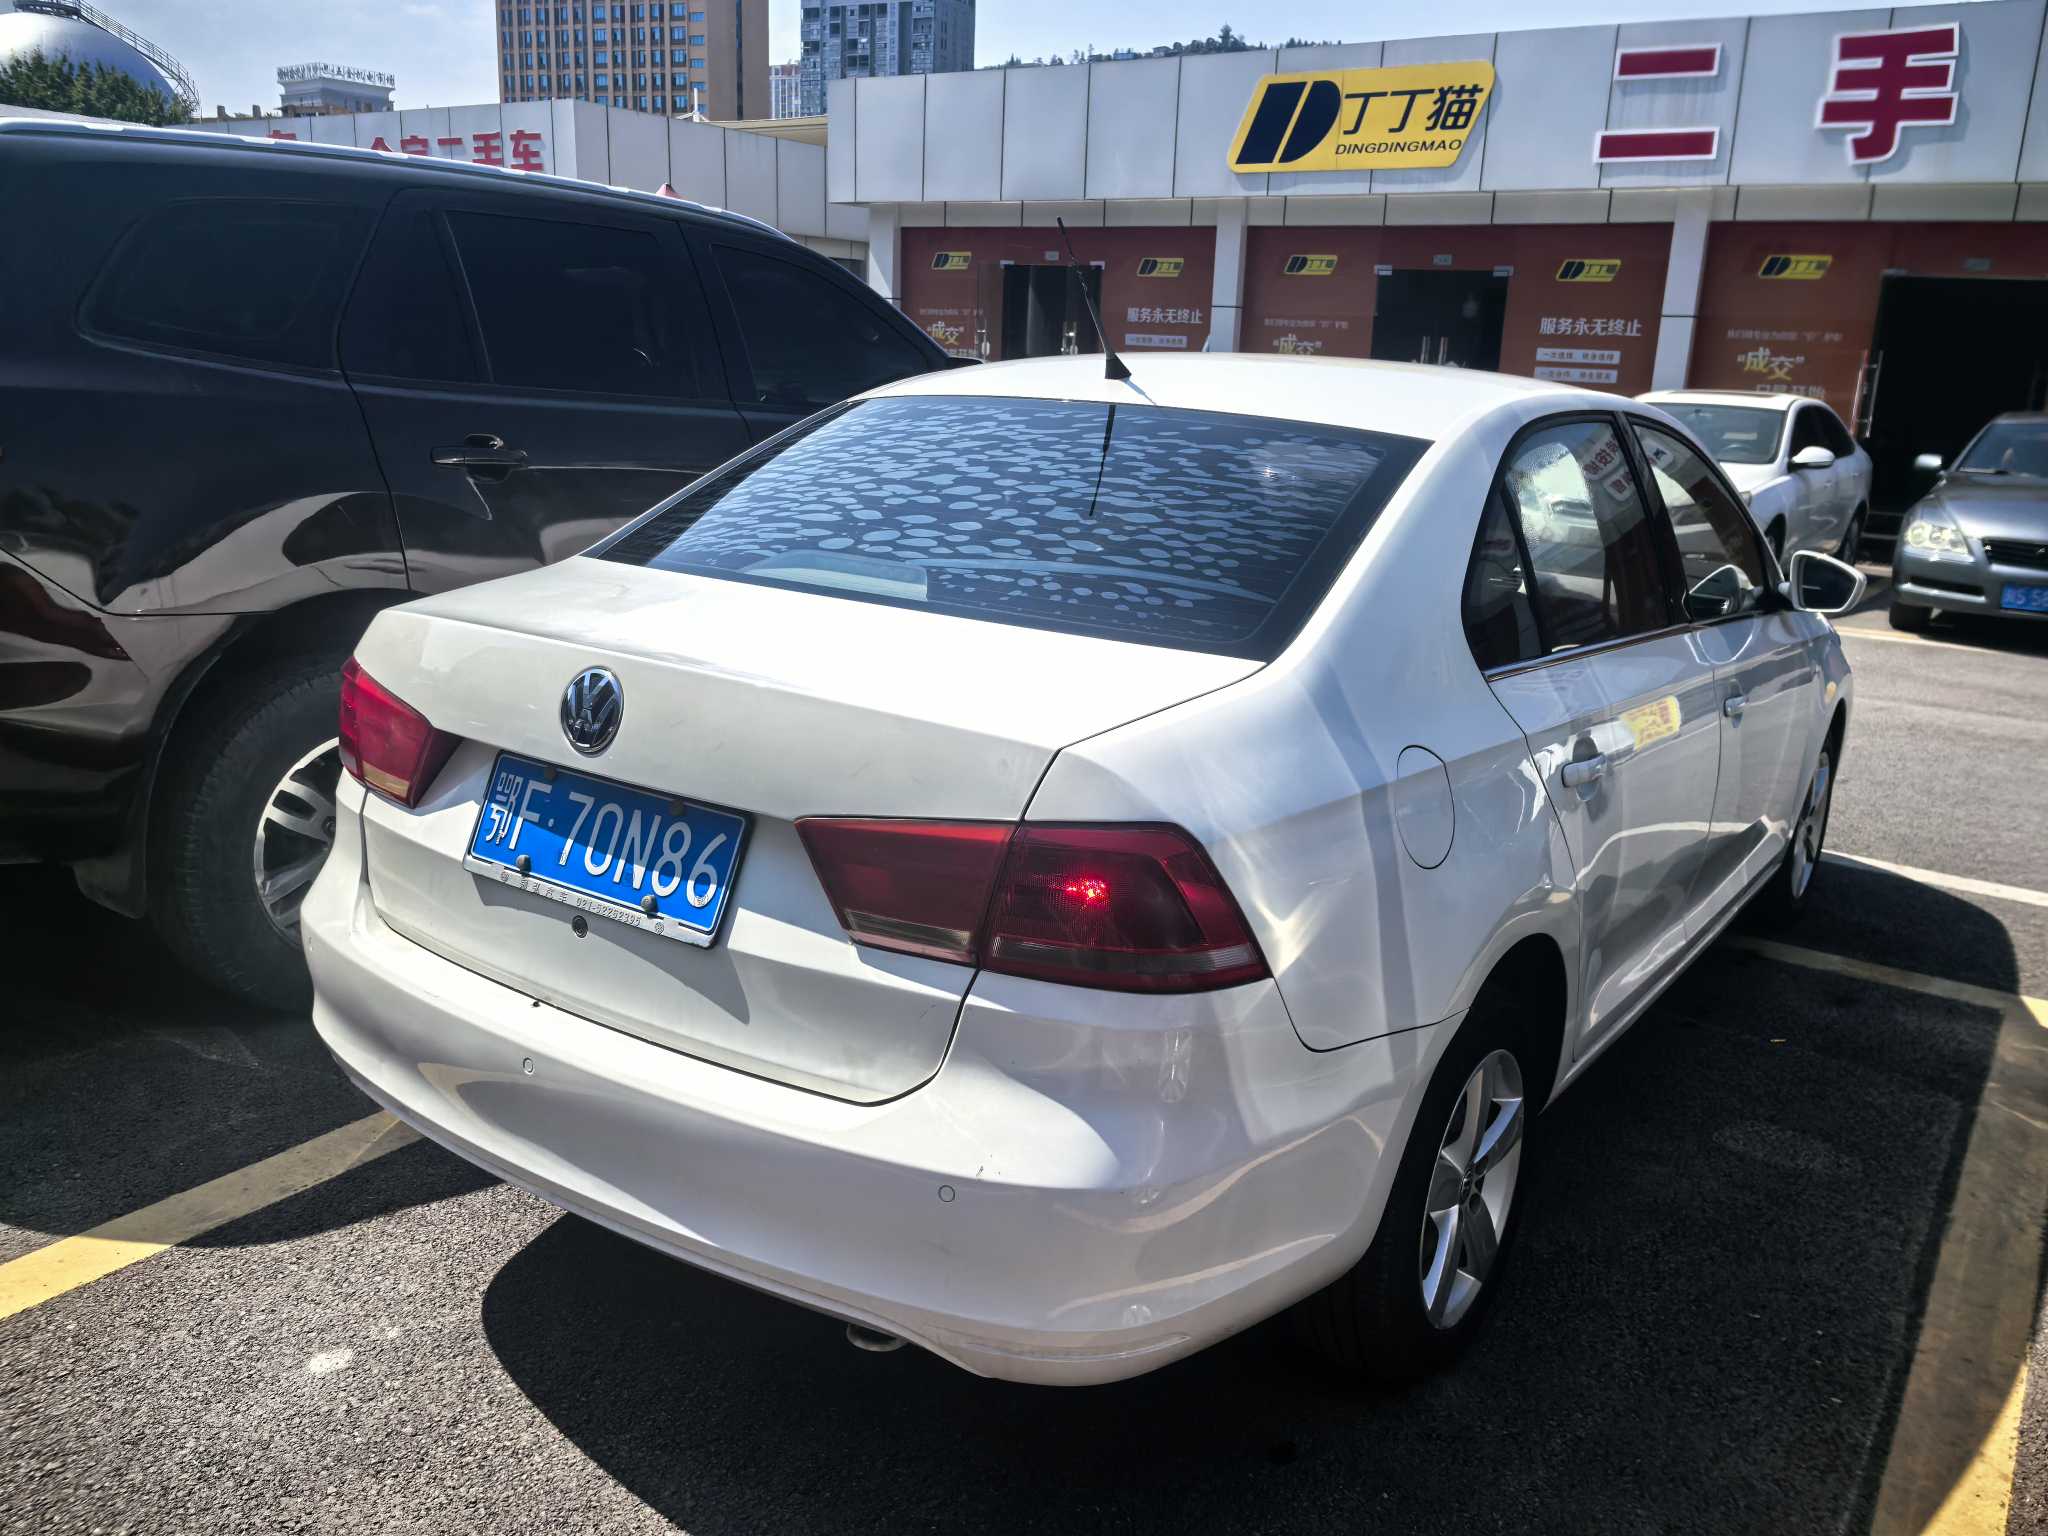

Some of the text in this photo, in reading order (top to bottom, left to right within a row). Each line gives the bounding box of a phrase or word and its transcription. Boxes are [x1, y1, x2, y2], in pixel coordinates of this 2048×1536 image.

[1343, 84, 1484, 135] 丁丁猫
[1335, 139, 1462, 155] DINGDINGMAO
[1127, 307, 1202, 324] 服务永无终止
[1539, 317, 1642, 337] 服务永无终止
